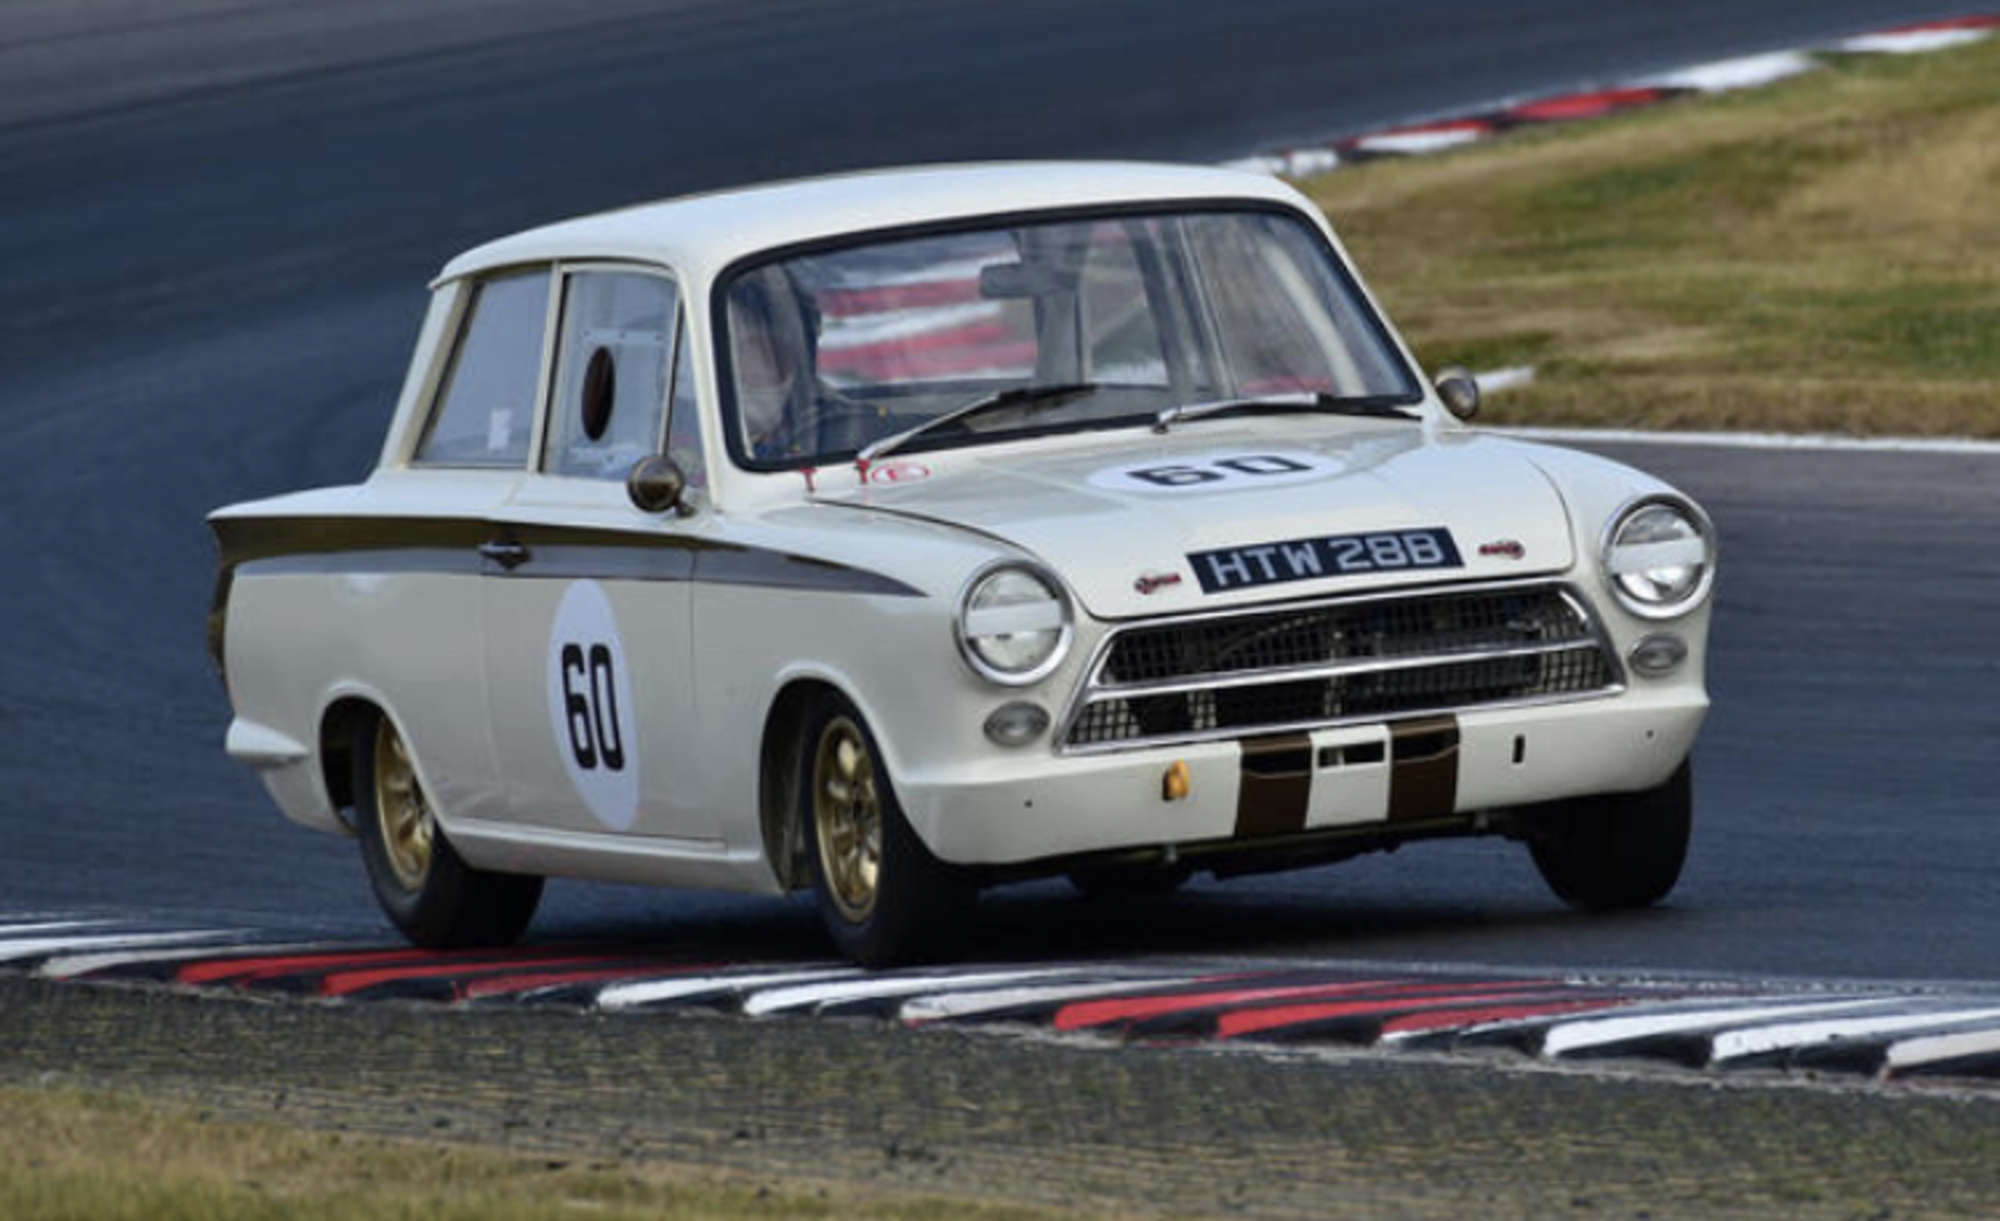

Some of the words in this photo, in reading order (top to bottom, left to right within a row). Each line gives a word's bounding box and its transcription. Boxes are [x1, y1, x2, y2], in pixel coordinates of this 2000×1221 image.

[1125, 456, 1313, 486] 60
[1208, 543, 1322, 586] HTW
[1330, 533, 1443, 569] 28B
[562, 643, 625, 771] 60
